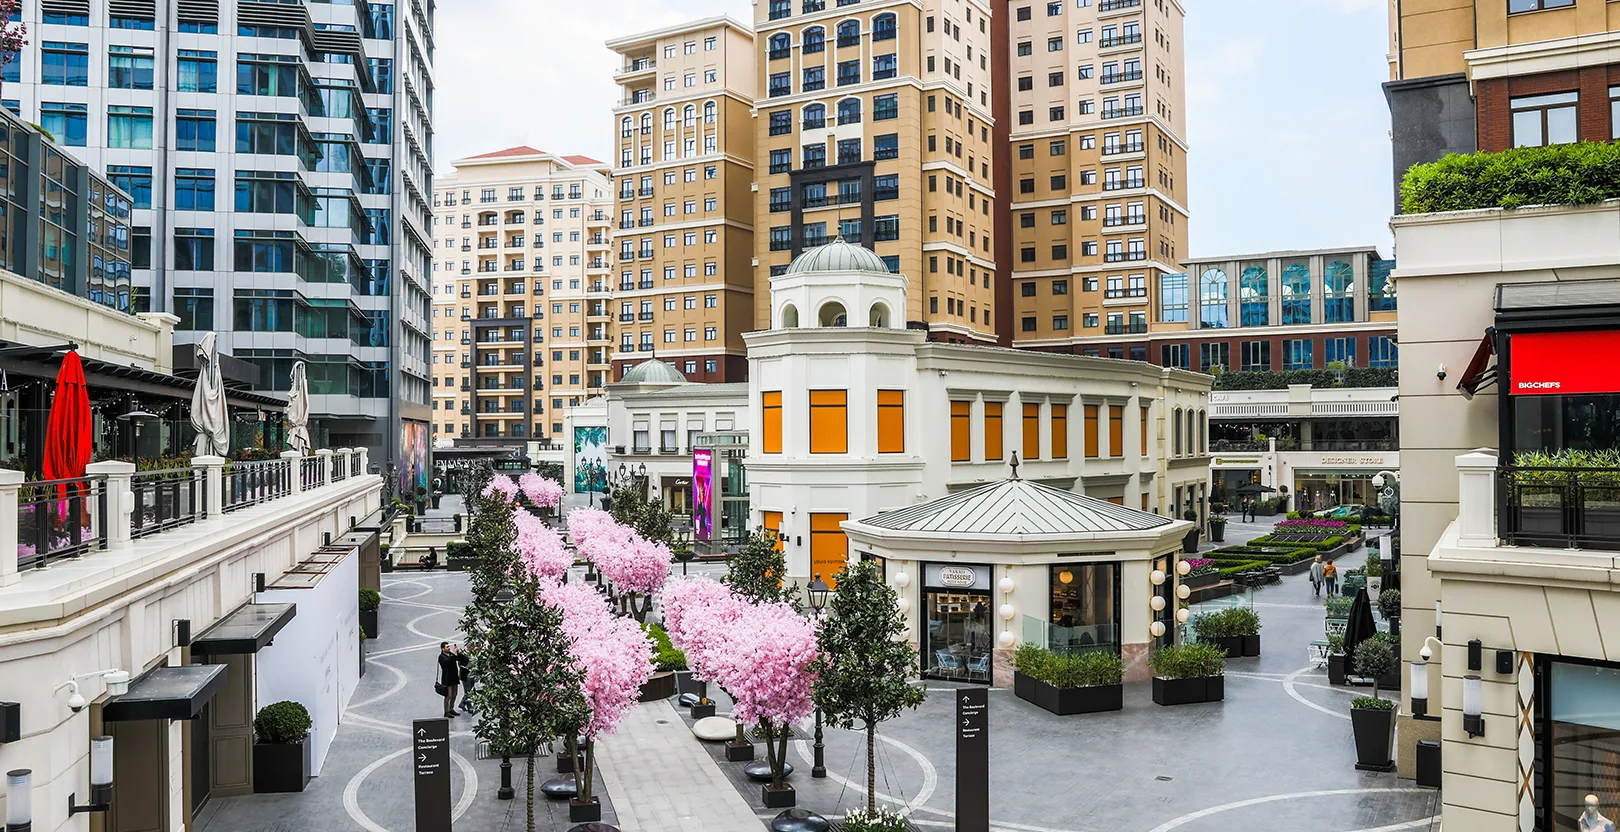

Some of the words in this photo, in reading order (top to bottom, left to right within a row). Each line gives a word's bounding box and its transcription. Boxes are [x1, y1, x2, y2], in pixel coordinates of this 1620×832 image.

[1518, 381, 1561, 389] BIGCHEFS
[1321, 456, 1358, 464] DESIGNER
[1360, 456, 1385, 464] STORE
[942, 573, 971, 581] PATISSERIE
